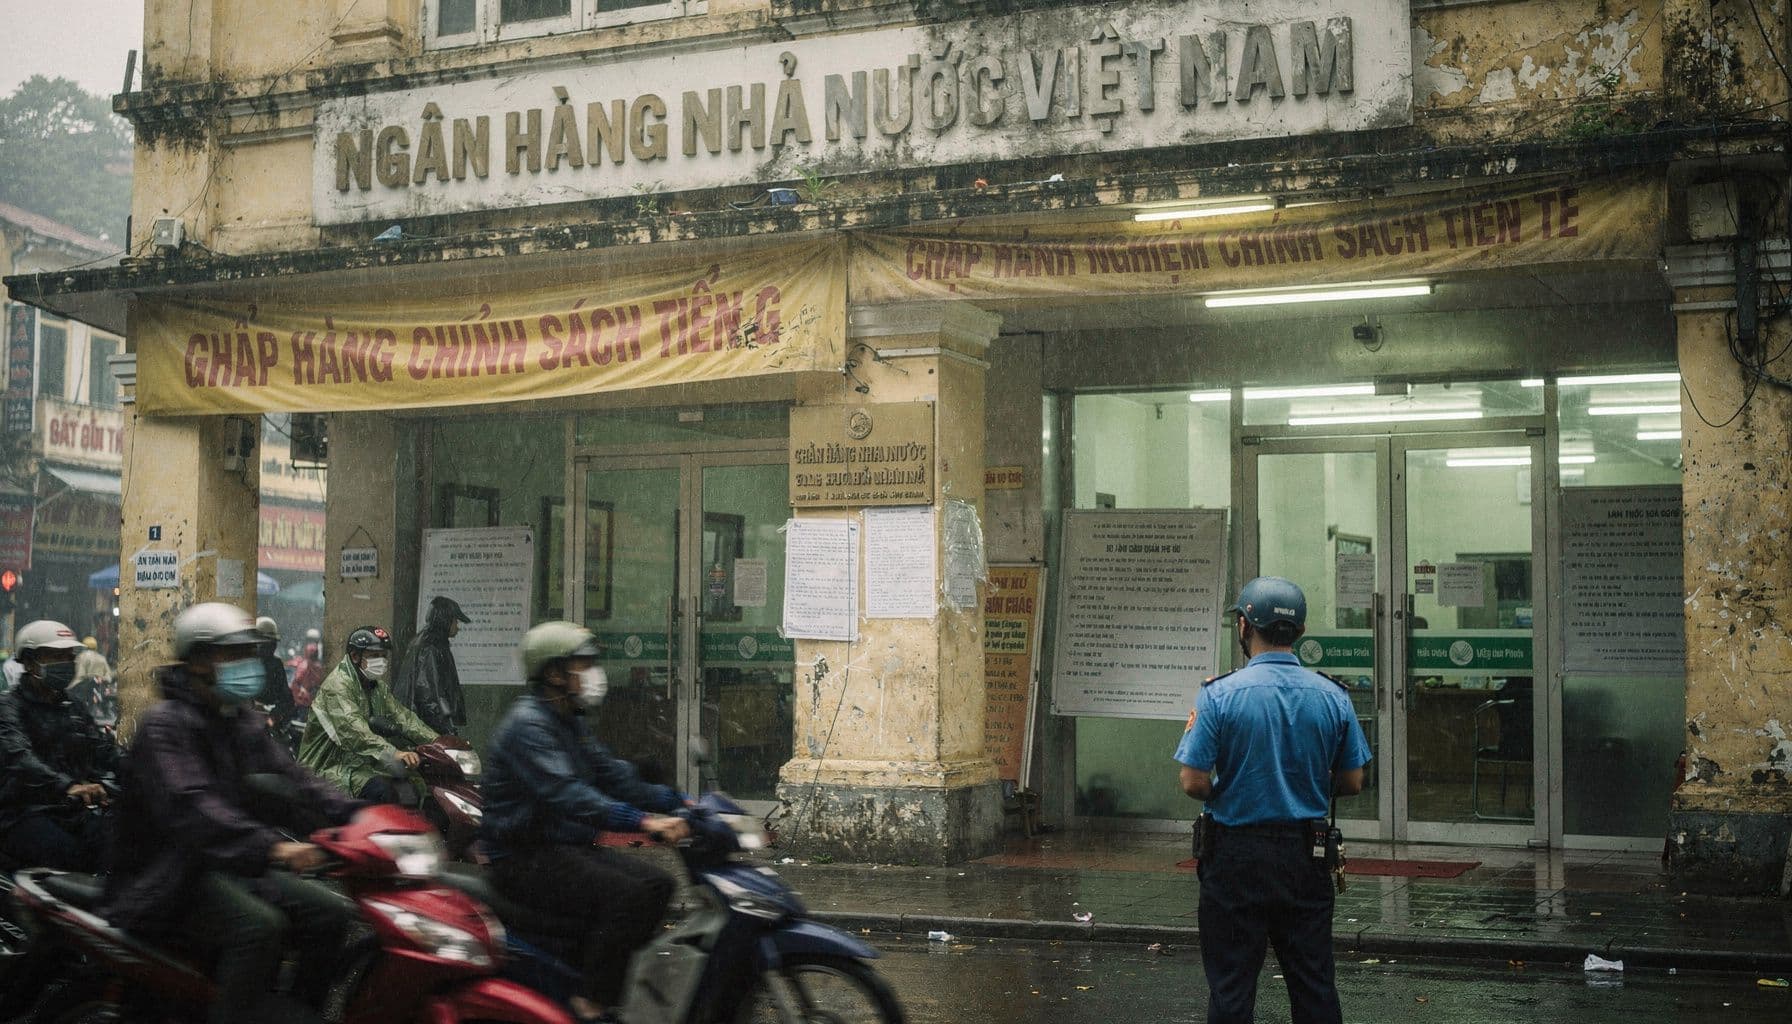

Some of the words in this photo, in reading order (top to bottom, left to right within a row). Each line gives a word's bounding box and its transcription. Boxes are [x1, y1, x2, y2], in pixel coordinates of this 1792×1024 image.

[335, 101, 490, 192] NGÂN
[505, 85, 668, 175] HÀNG
[682, 51, 812, 157] NHẢ
[823, 41, 1003, 141] NƯỚC
[1017, 23, 1165, 132] VIỆT
[1179, 16, 1354, 106] NAM
[539, 297, 642, 371] SÁCH
[151, 527, 158, 538] 1
